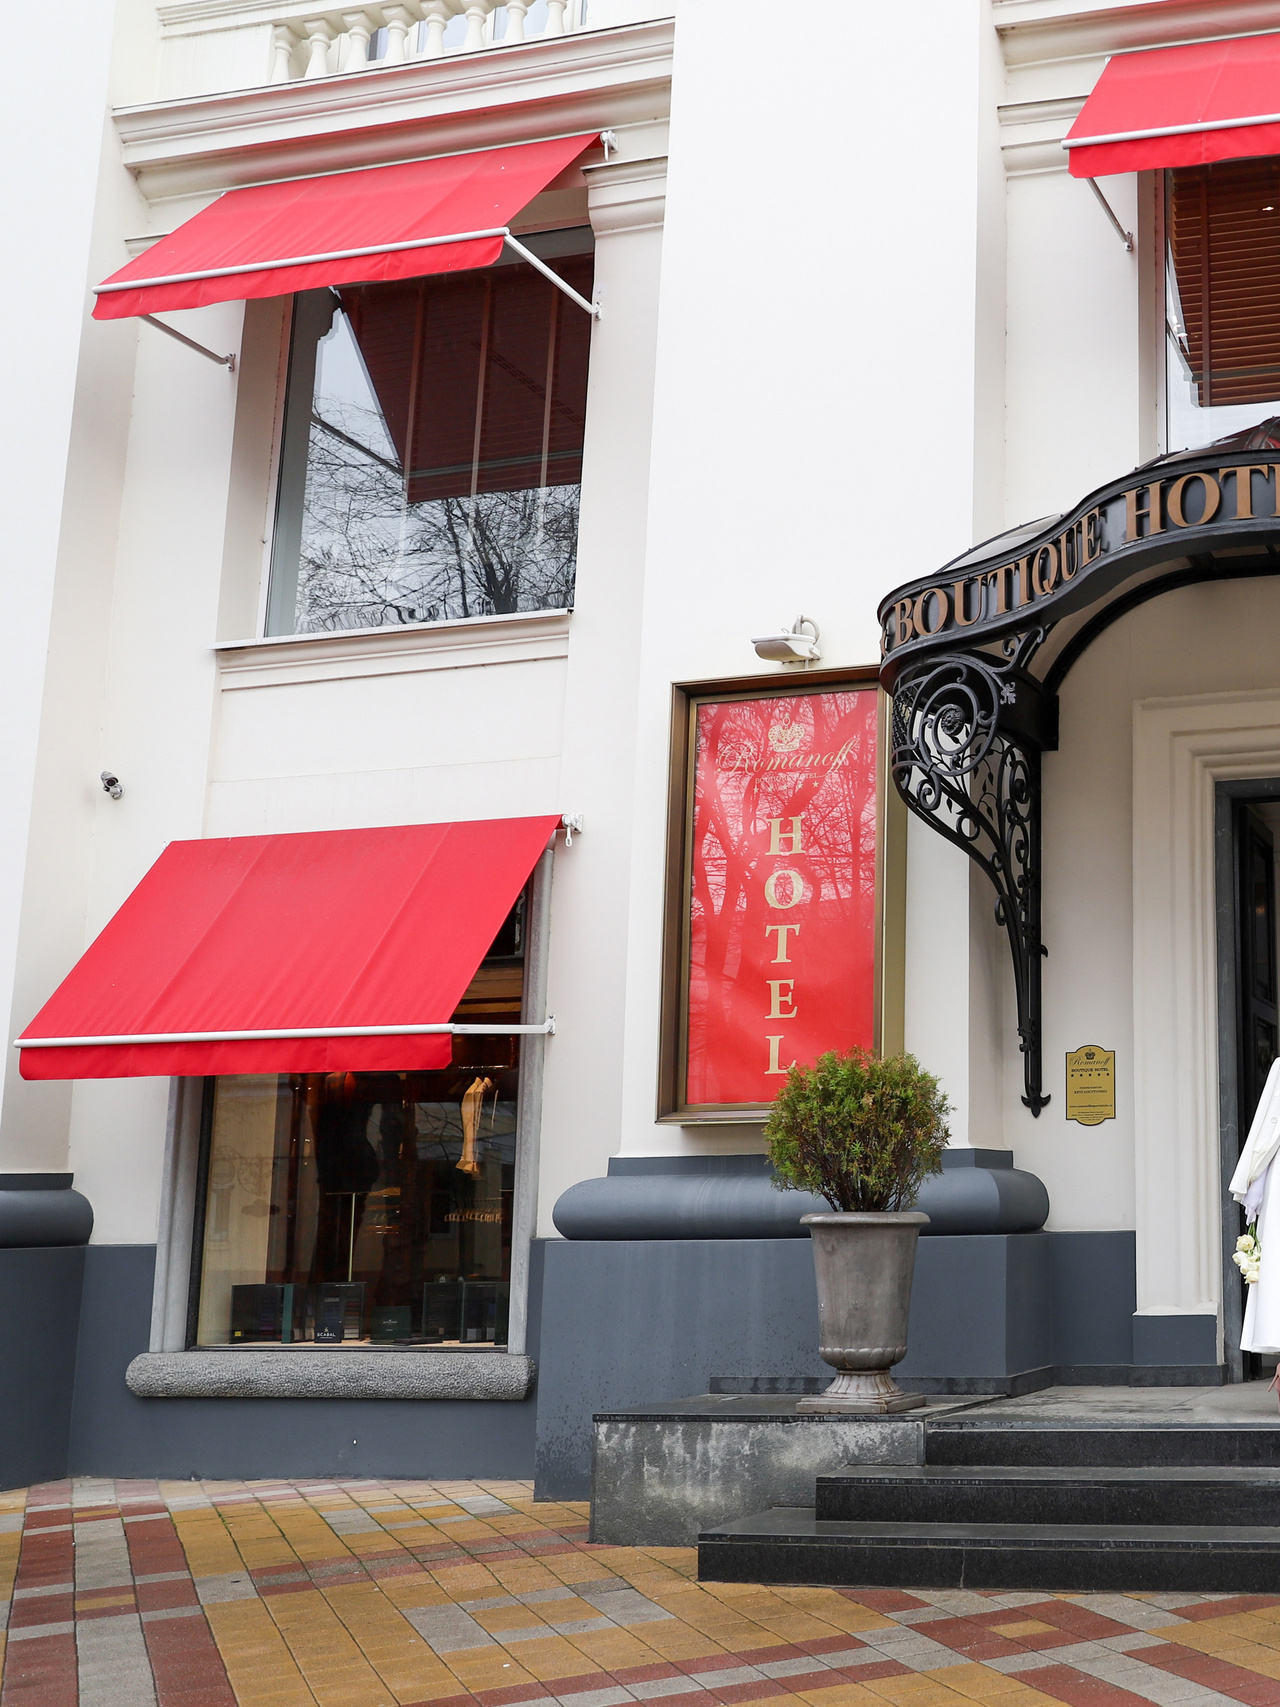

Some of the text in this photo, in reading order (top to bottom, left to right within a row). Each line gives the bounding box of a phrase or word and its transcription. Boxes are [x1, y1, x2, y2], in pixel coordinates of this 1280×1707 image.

[892, 506, 1101, 648] BOUTIQUE
[716, 738, 860, 777] Romanoff
[763, 815, 806, 1075] HOTEL
[1069, 1056, 1111, 1066] Romanoff
